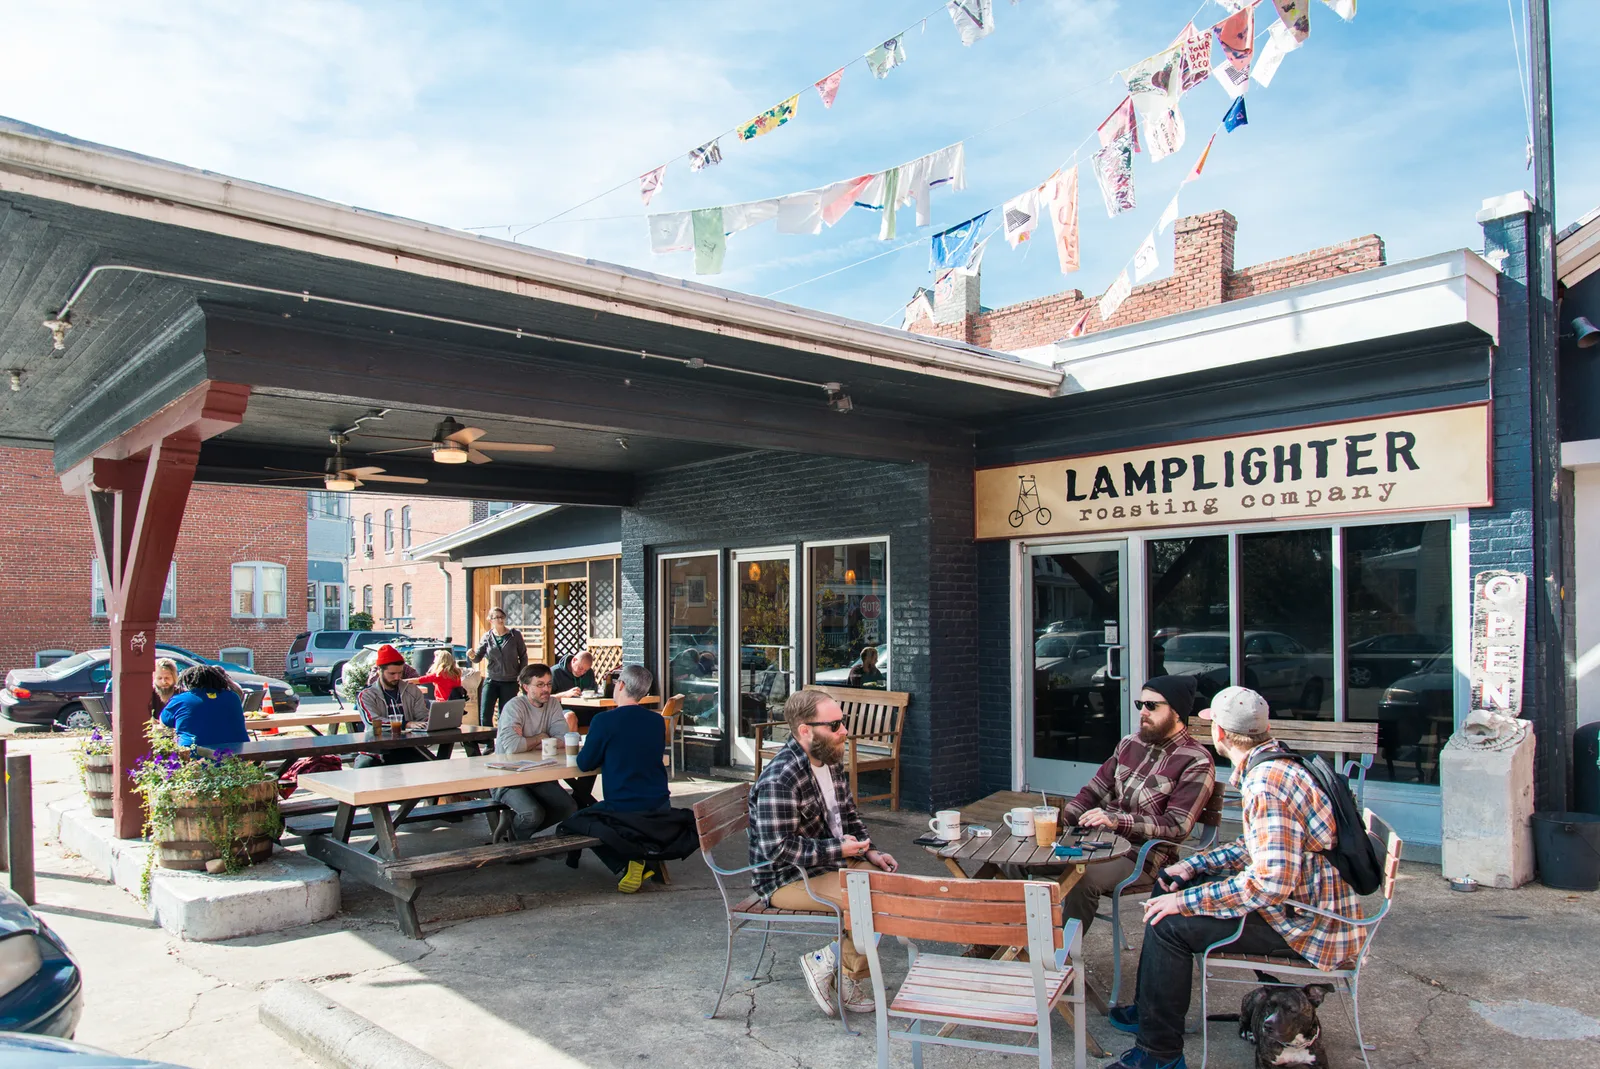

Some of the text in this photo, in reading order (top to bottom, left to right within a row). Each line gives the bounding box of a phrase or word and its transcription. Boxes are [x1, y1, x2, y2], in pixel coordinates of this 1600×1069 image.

[1066, 431, 1420, 502] LAMPLIGHTER
[1079, 482, 1397, 521] roasting company
[1482, 575, 1517, 708] OPEN
